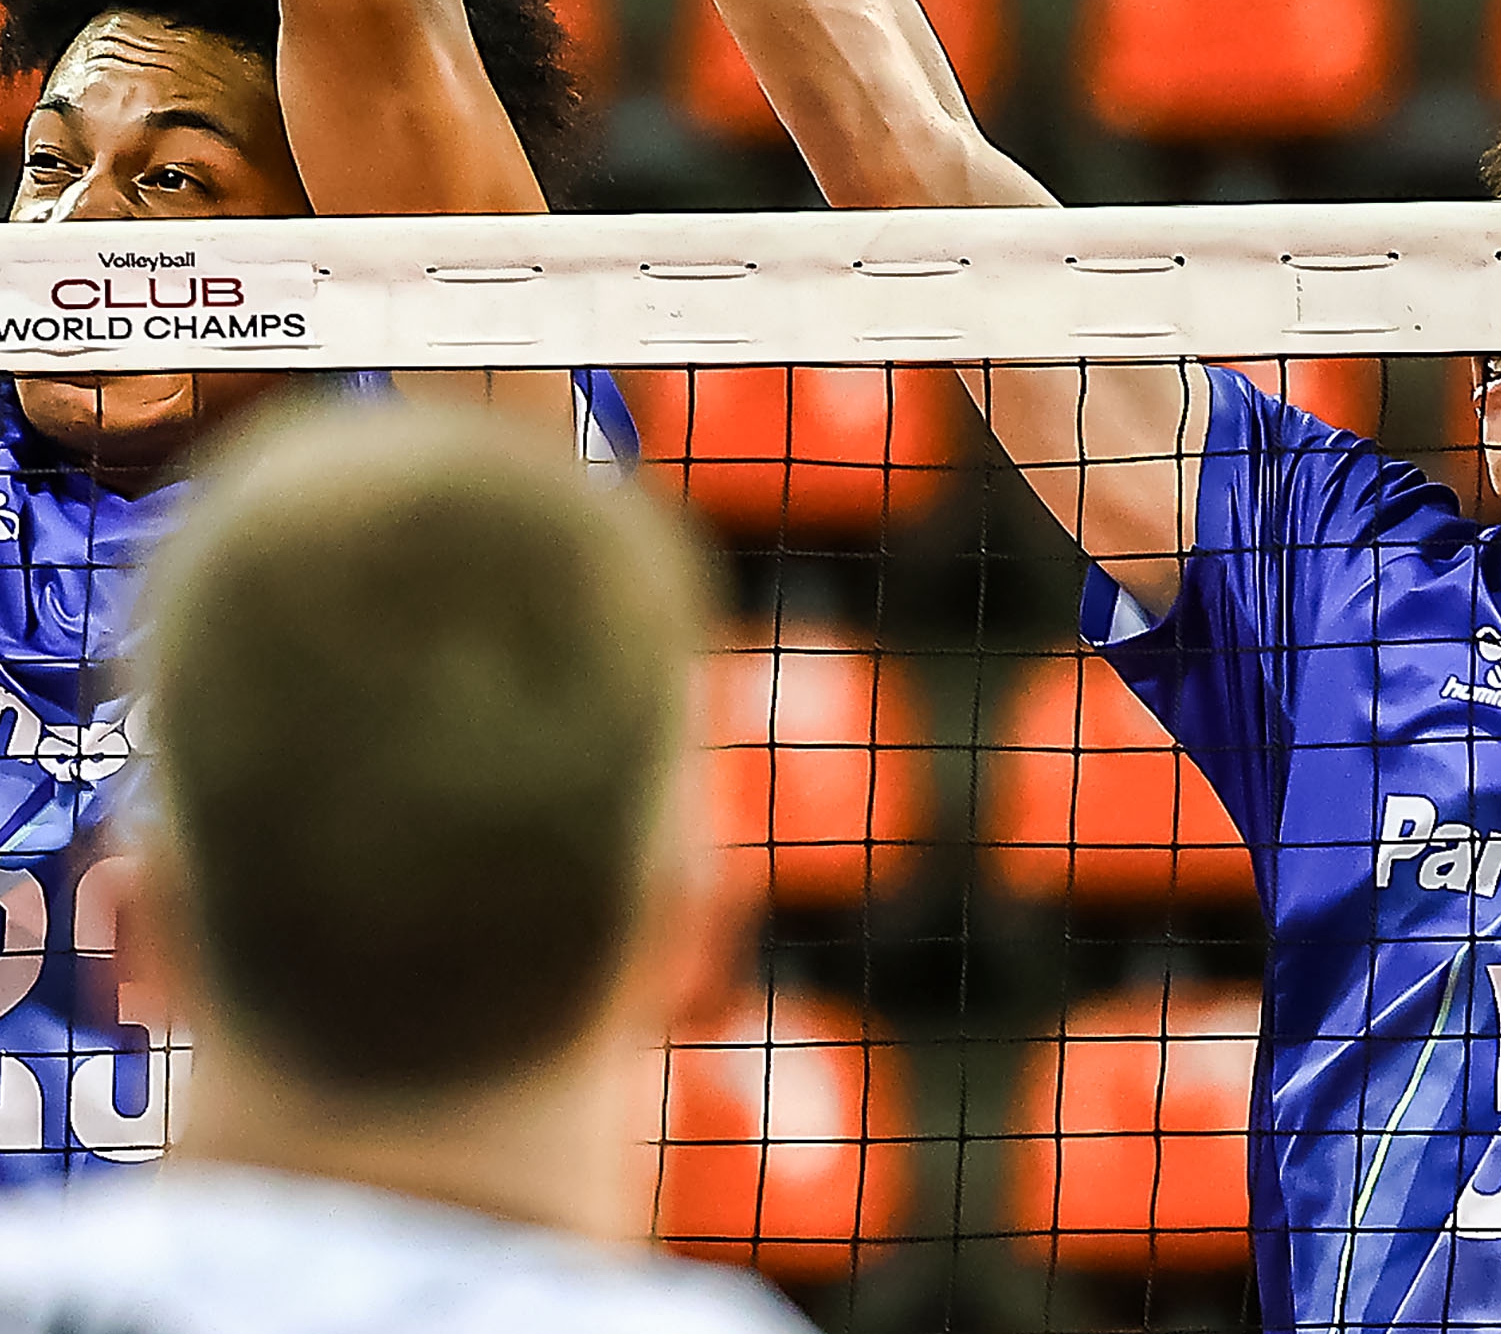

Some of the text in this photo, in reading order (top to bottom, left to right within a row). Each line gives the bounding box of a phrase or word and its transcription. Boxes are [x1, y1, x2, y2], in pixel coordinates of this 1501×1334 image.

[98, 251, 196, 272] Volleyball
[51, 277, 245, 311] CLUB
[143, 313, 307, 340] CHAMPS
